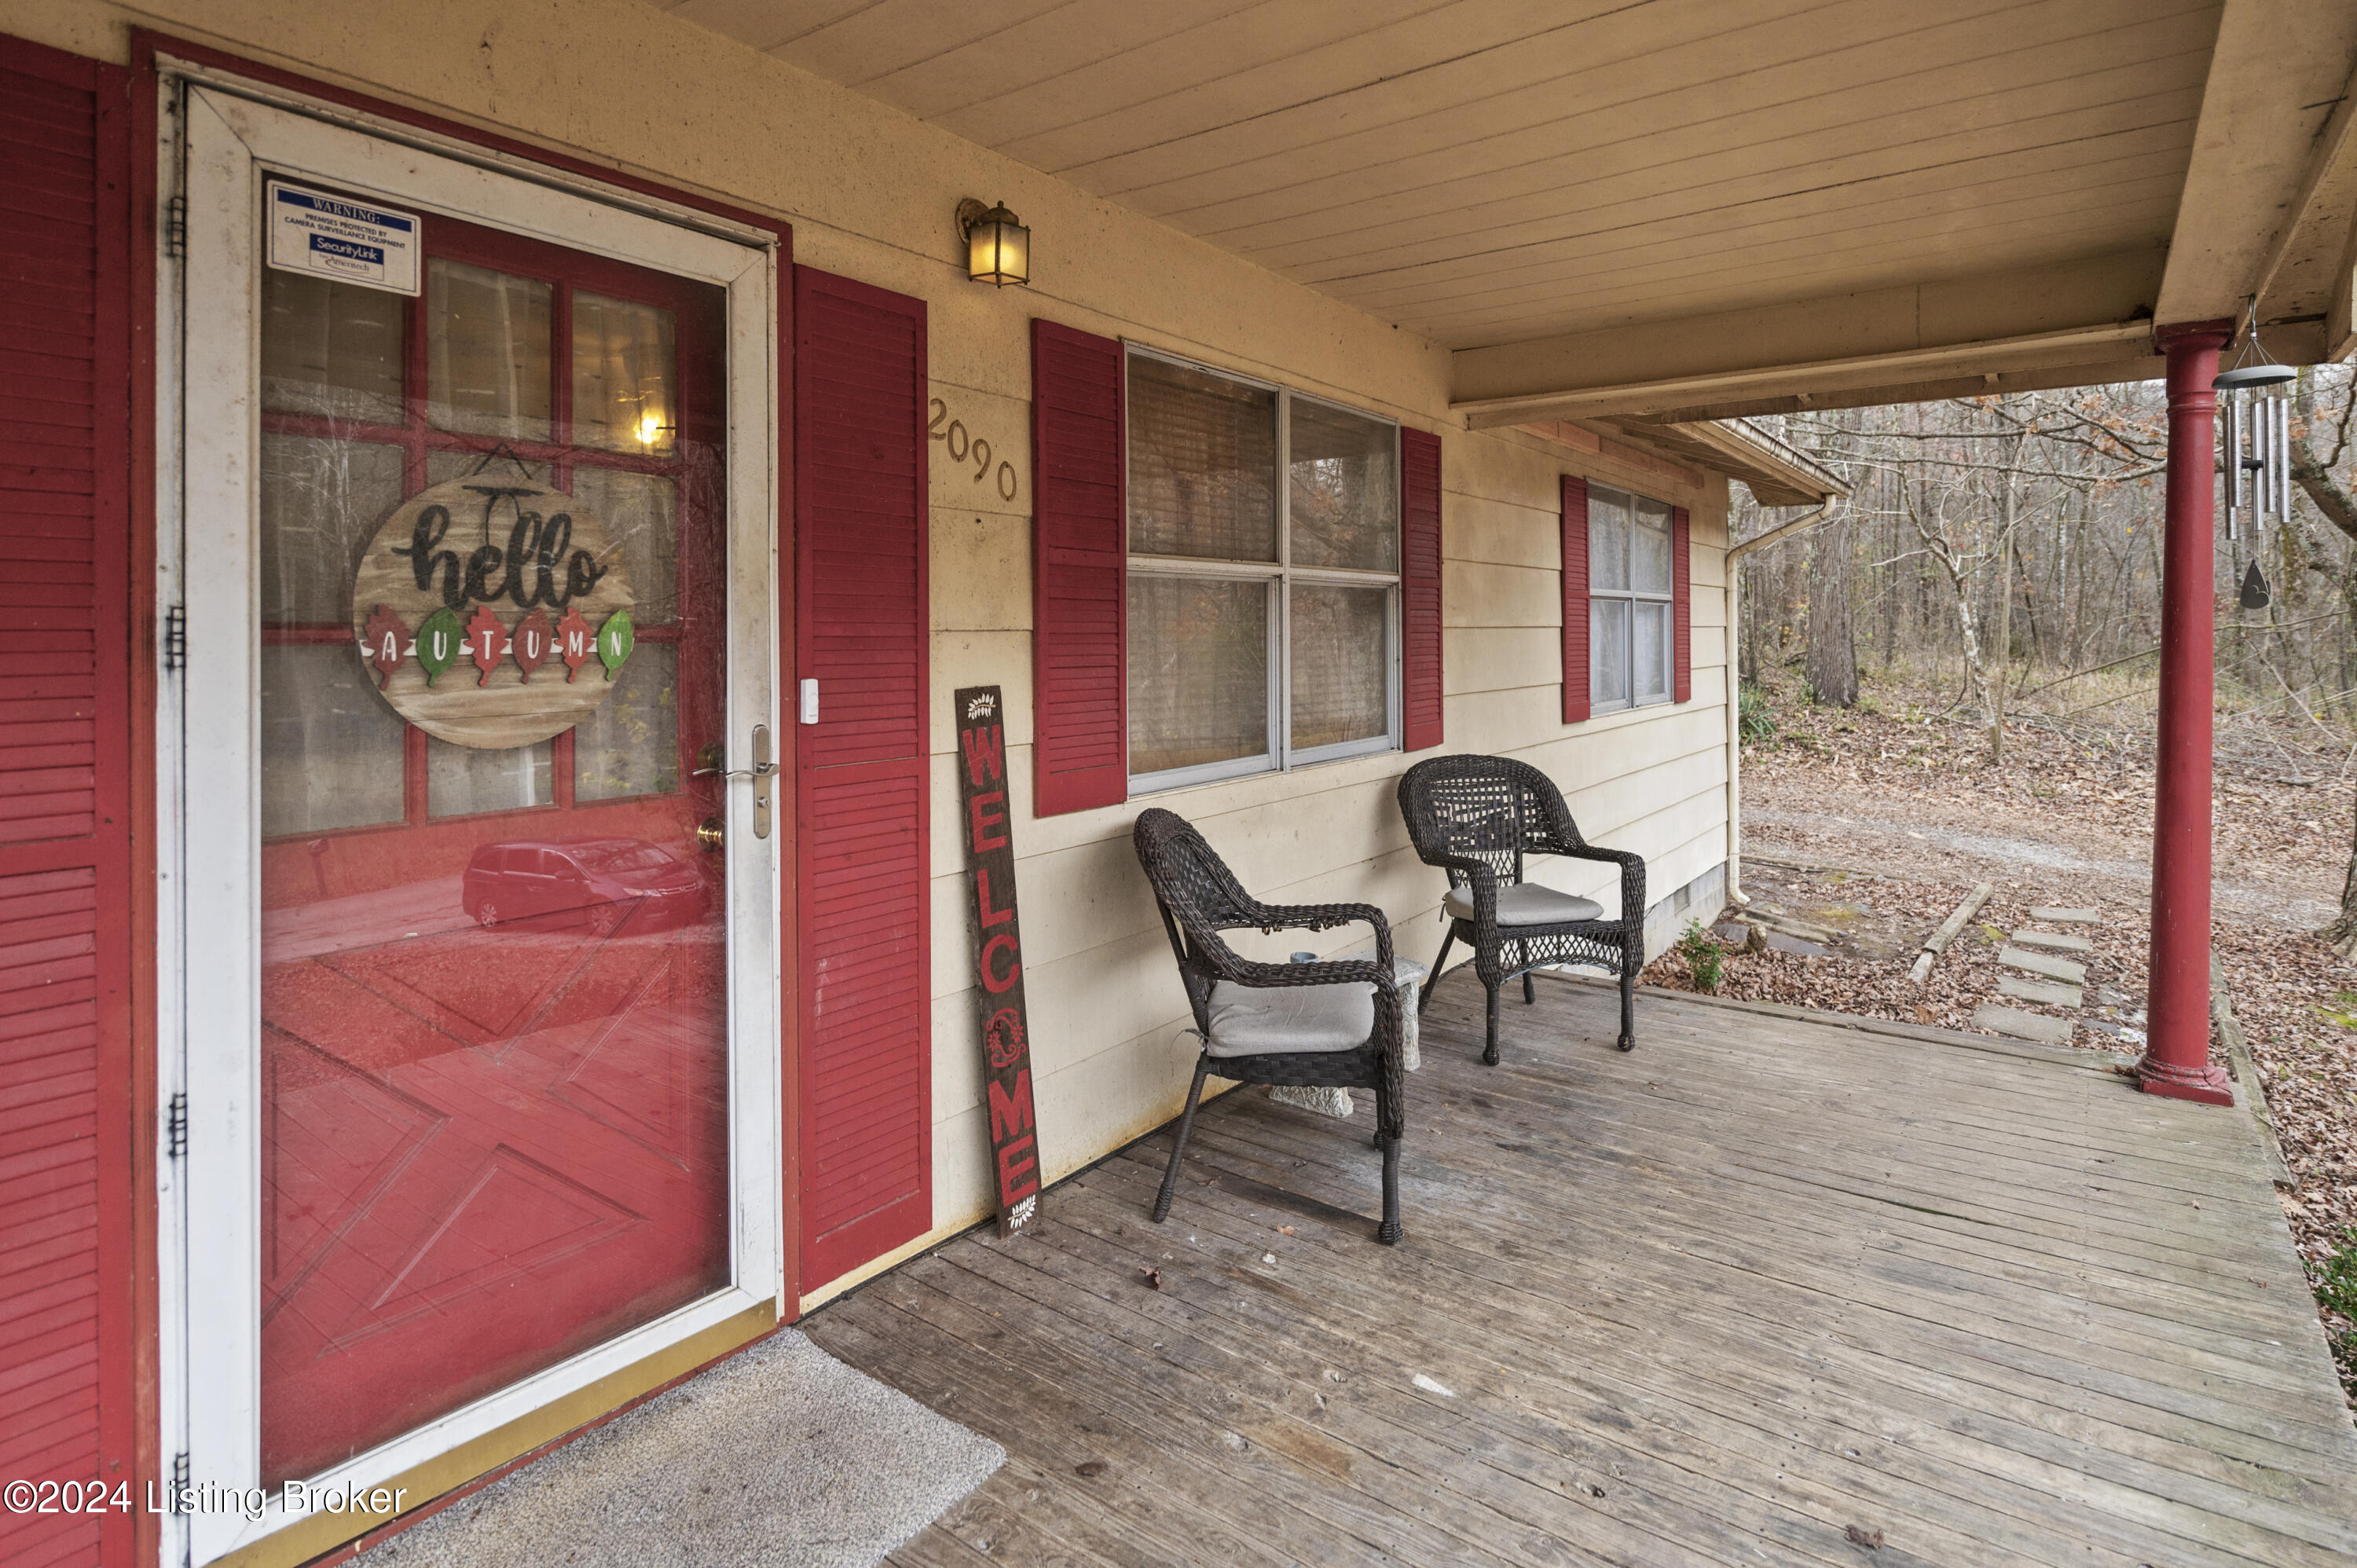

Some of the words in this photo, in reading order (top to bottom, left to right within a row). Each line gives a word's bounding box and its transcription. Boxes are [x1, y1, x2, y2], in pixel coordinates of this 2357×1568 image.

[306, 213, 338, 226] PREMISES
[339, 222, 377, 235] PROTECTED
[313, 198, 380, 224] WARNING:
[284, 216, 316, 229] CAMERA
[317, 224, 365, 240] SURVEILLANCE
[368, 236, 405, 248] EQUIPMENT
[317, 237, 378, 260] SecurityLink
[329, 256, 369, 271] Ameritech
[929, 398, 1017, 503] 2090
[391, 504, 608, 610] hello
[382, 631, 622, 662] AUTUMN
[962, 724, 1037, 1208] WELCOME
